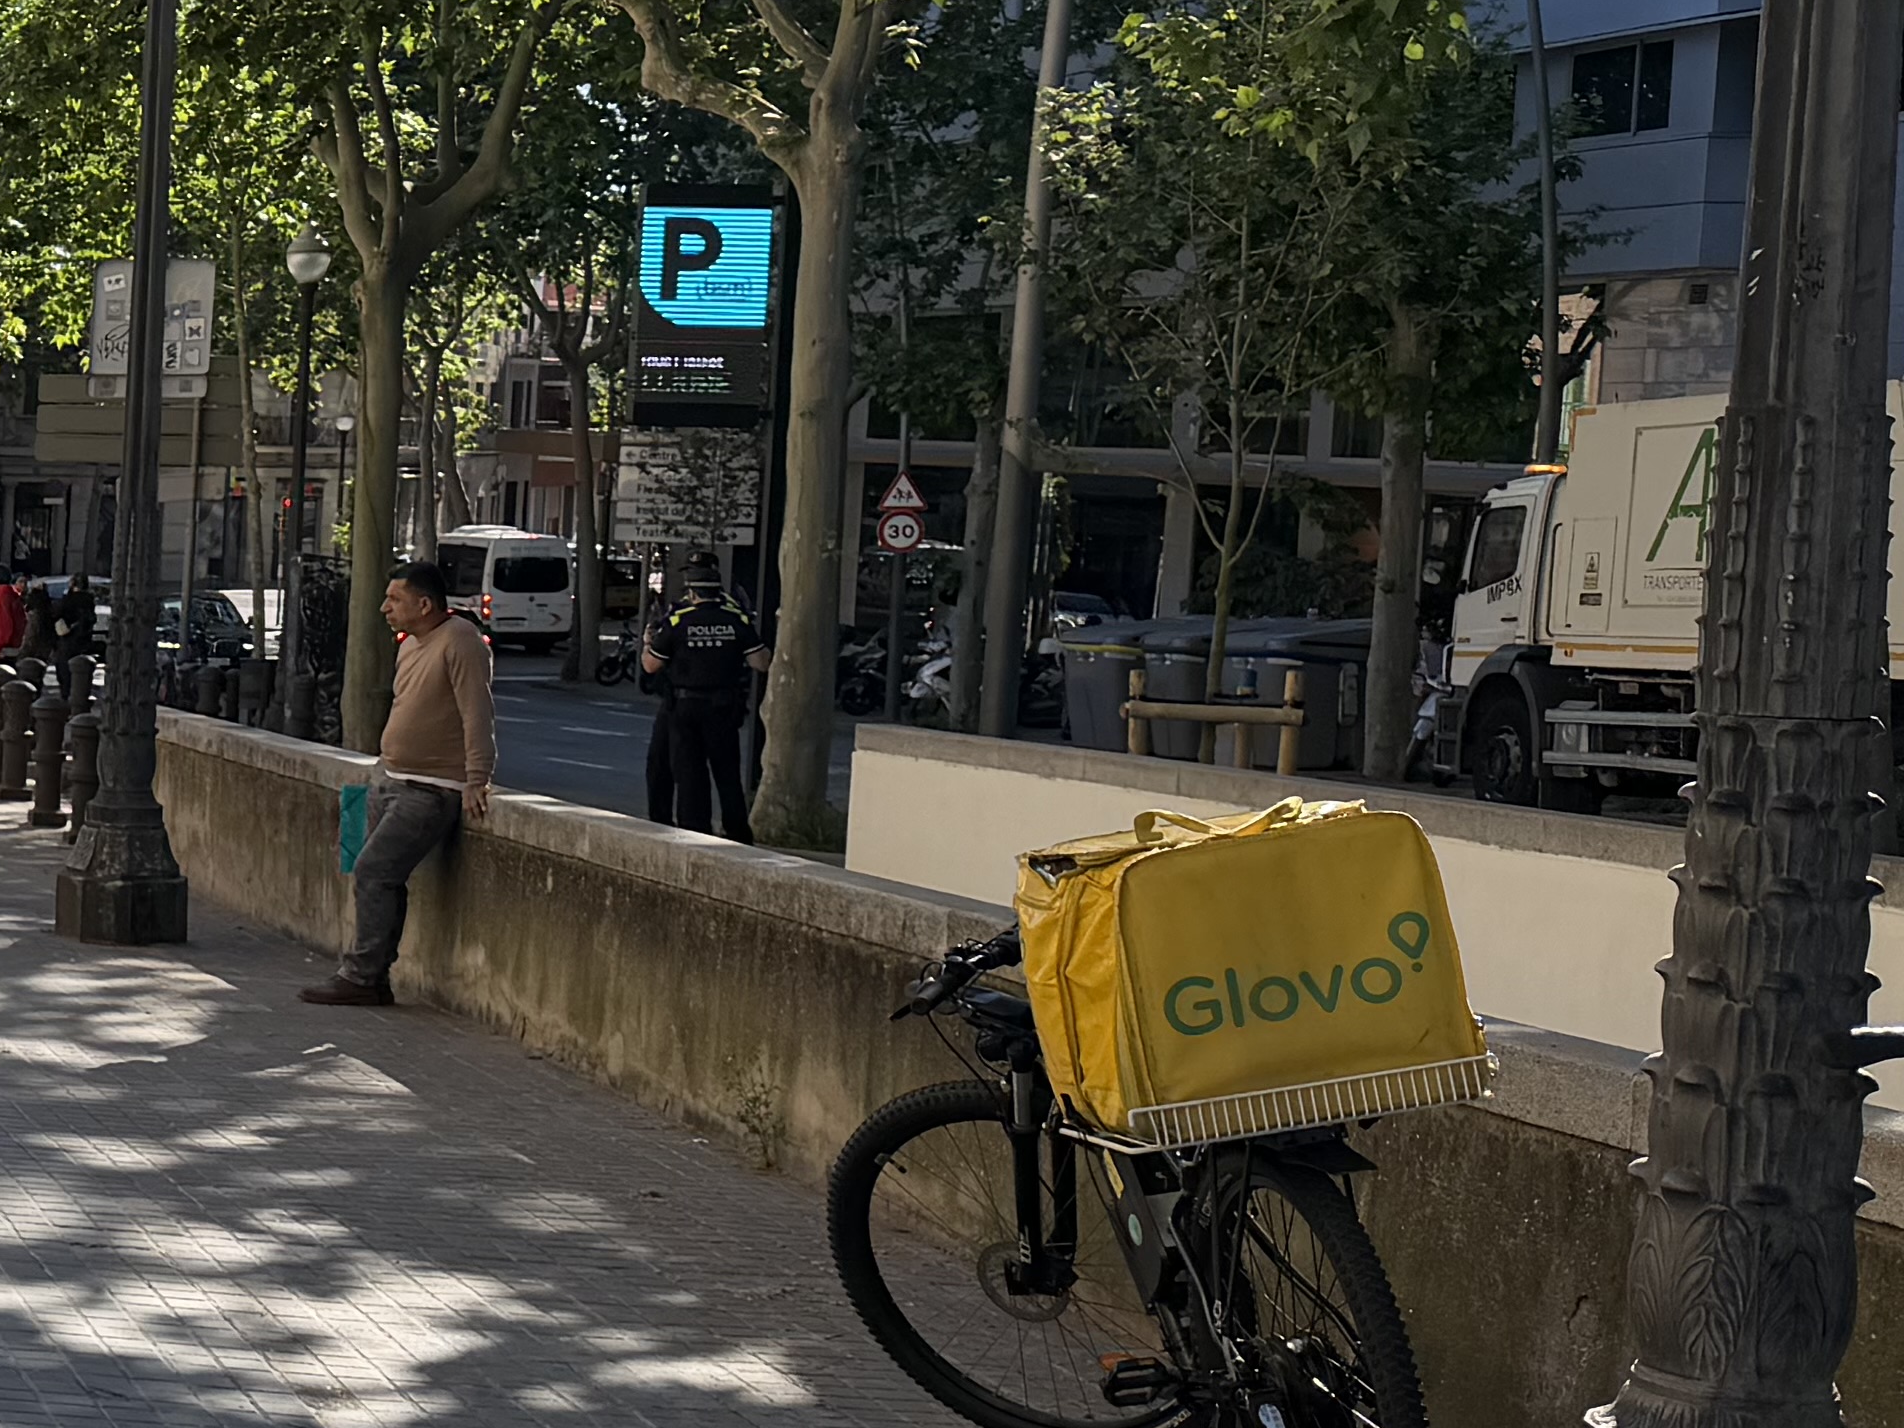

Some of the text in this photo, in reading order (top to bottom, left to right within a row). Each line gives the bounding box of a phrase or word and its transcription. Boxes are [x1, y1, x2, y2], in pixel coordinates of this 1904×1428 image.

[660, 216, 723, 300] P
[887, 523, 915, 539] 30
[687, 625, 735, 635] POLICIA
[1163, 957, 1403, 1036] Glovo
